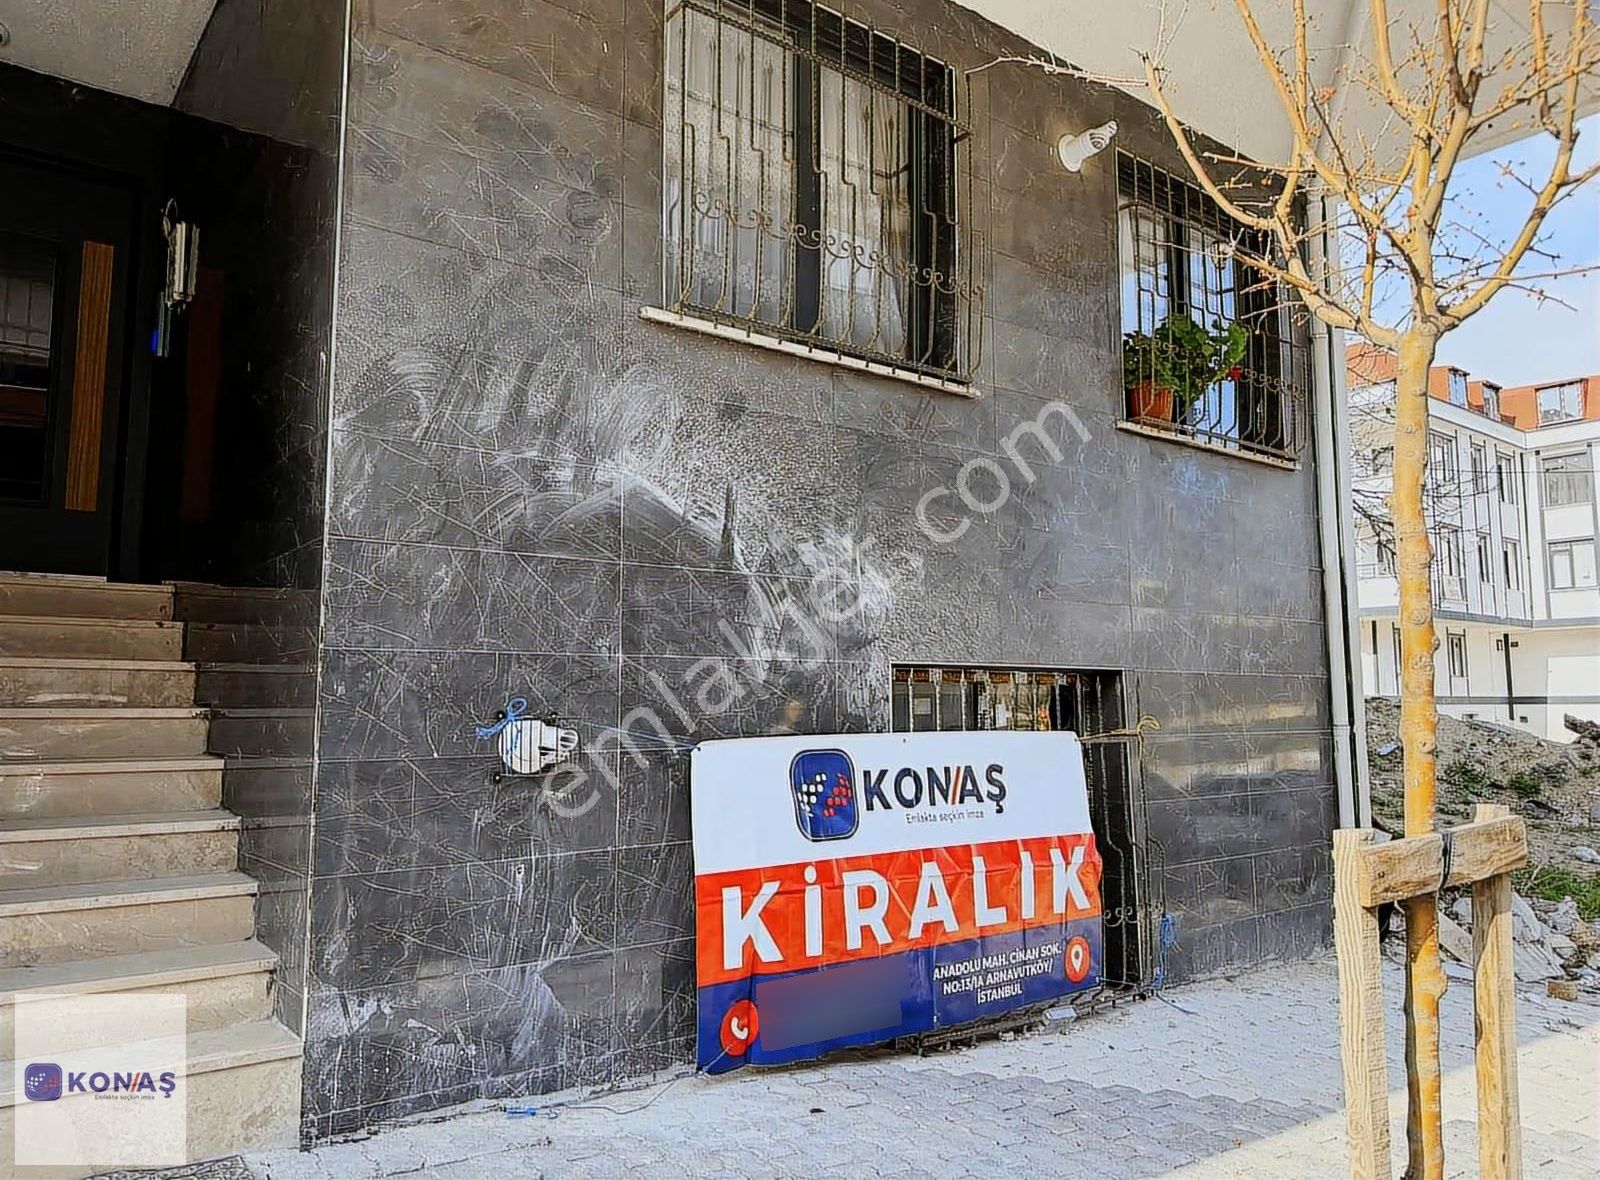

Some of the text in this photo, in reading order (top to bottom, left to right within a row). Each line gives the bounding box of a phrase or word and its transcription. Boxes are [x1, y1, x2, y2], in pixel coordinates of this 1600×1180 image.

[906, 809, 984, 824] Emlakta seçkin imza
[721, 845, 1092, 970] KİRALIK
[933, 958, 981, 981] ANADOLU
[982, 954, 1008, 970] MAH.
[977, 983, 1023, 1004] İSTANBUL
